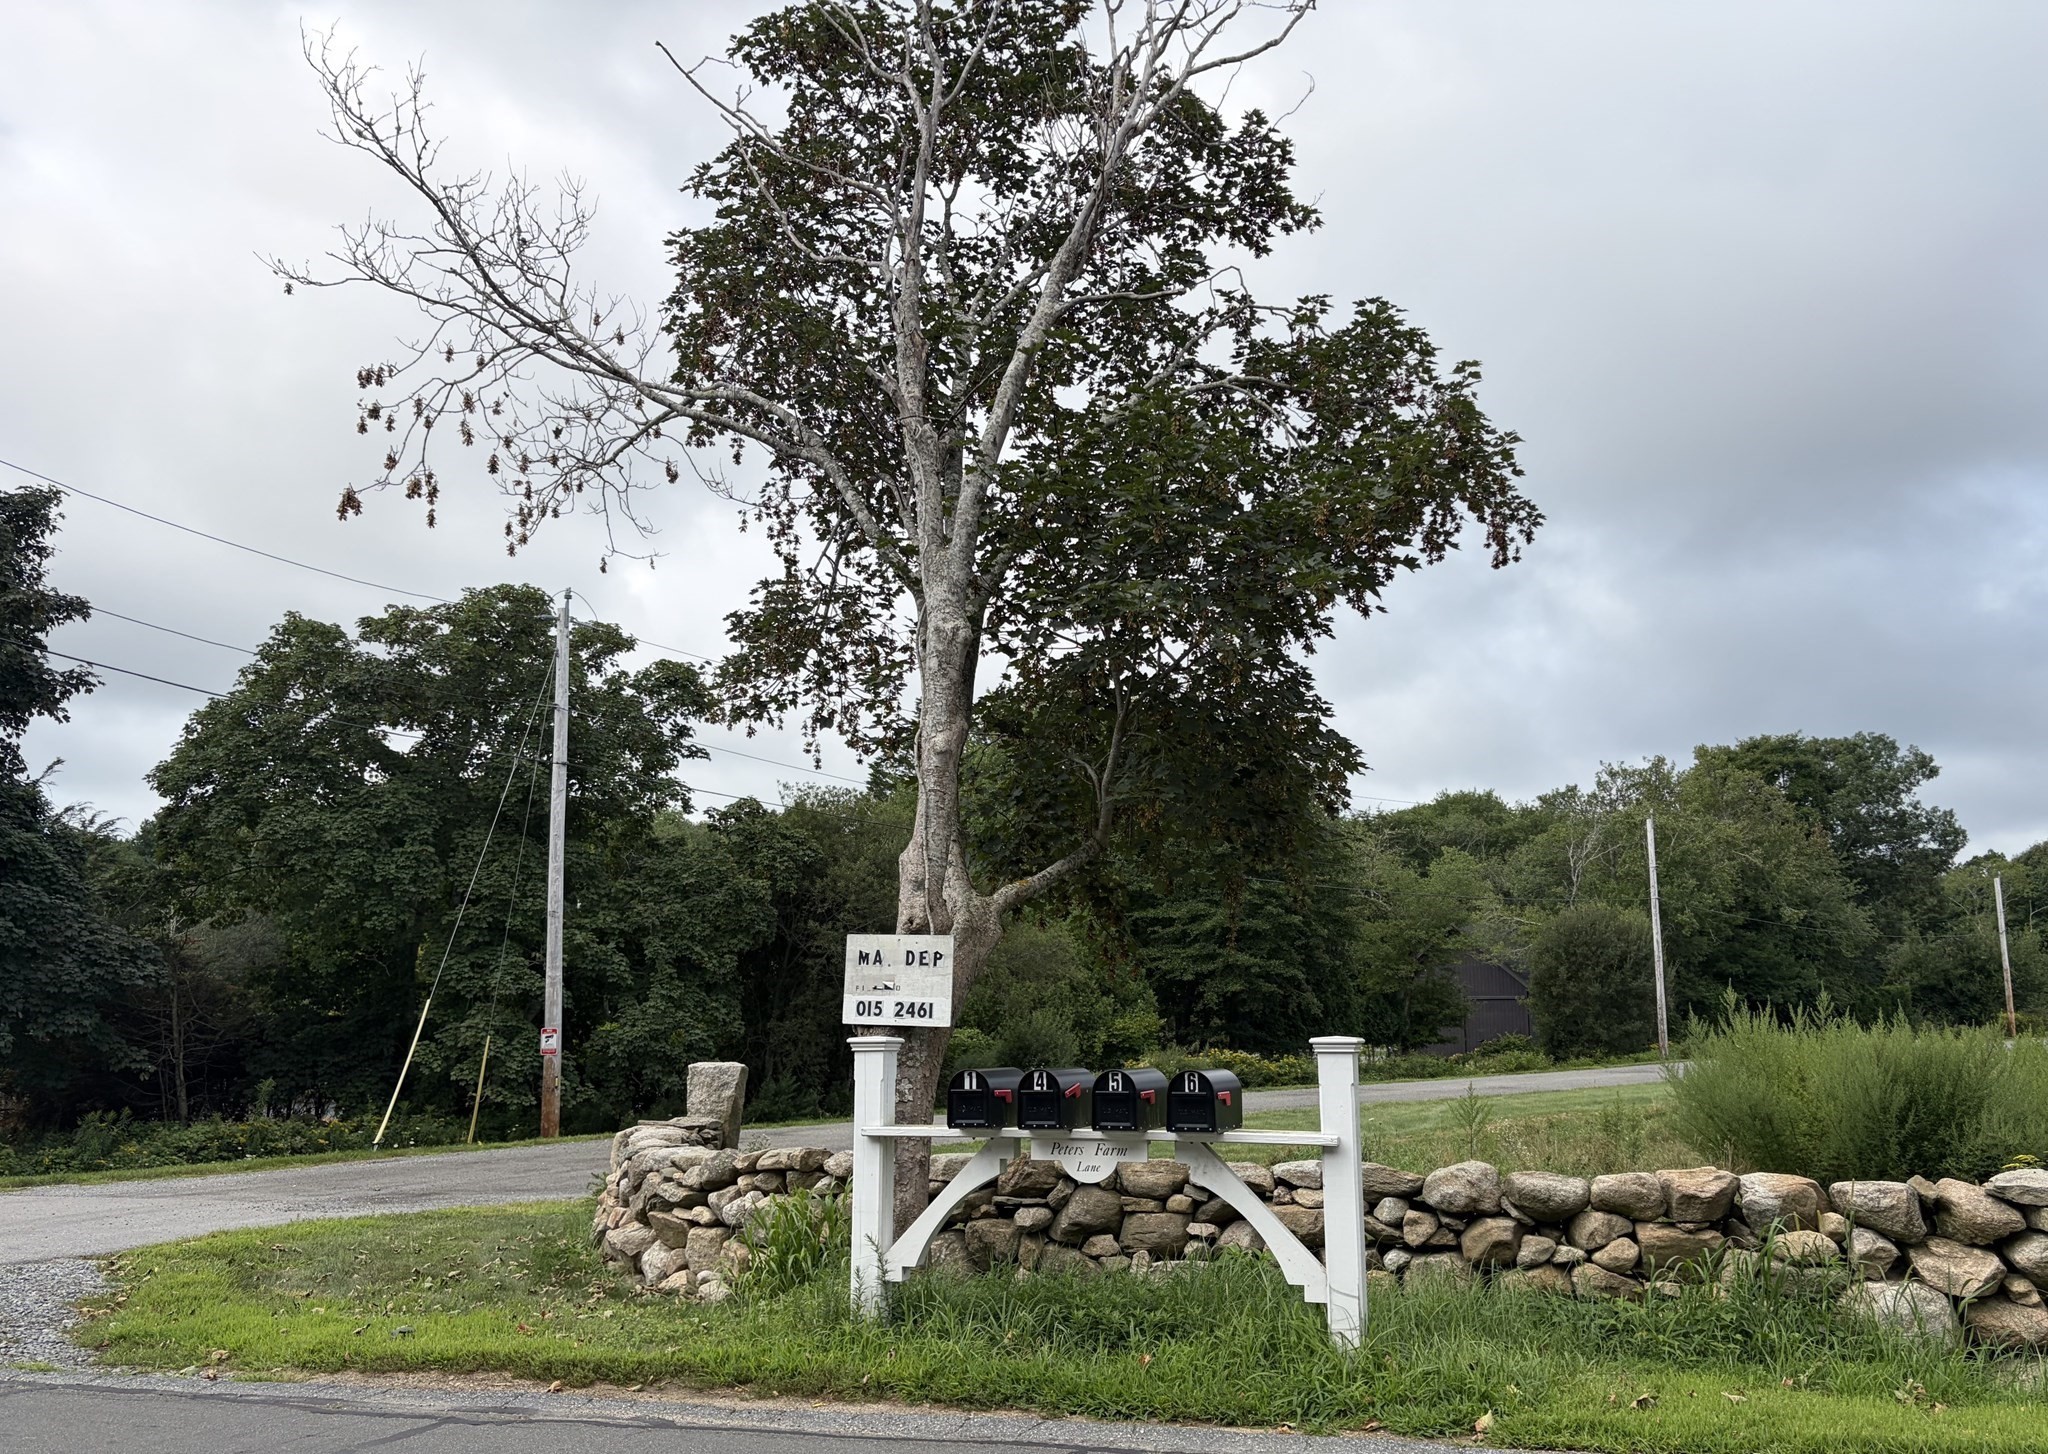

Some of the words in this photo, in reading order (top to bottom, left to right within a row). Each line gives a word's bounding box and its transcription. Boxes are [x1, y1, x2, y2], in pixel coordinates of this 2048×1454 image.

[905, 950, 944, 967] DEP
[856, 1001, 883, 1017] 015
[894, 1002, 934, 1018] 2461
[1035, 1071, 1046, 1091] 4
[1110, 1072, 1120, 1092] 5
[1187, 1072, 1197, 1093] 6
[1050, 1142, 1085, 1155] Peters
[1095, 1143, 1128, 1156] Farm
[1076, 1161, 1101, 1172] Lane
